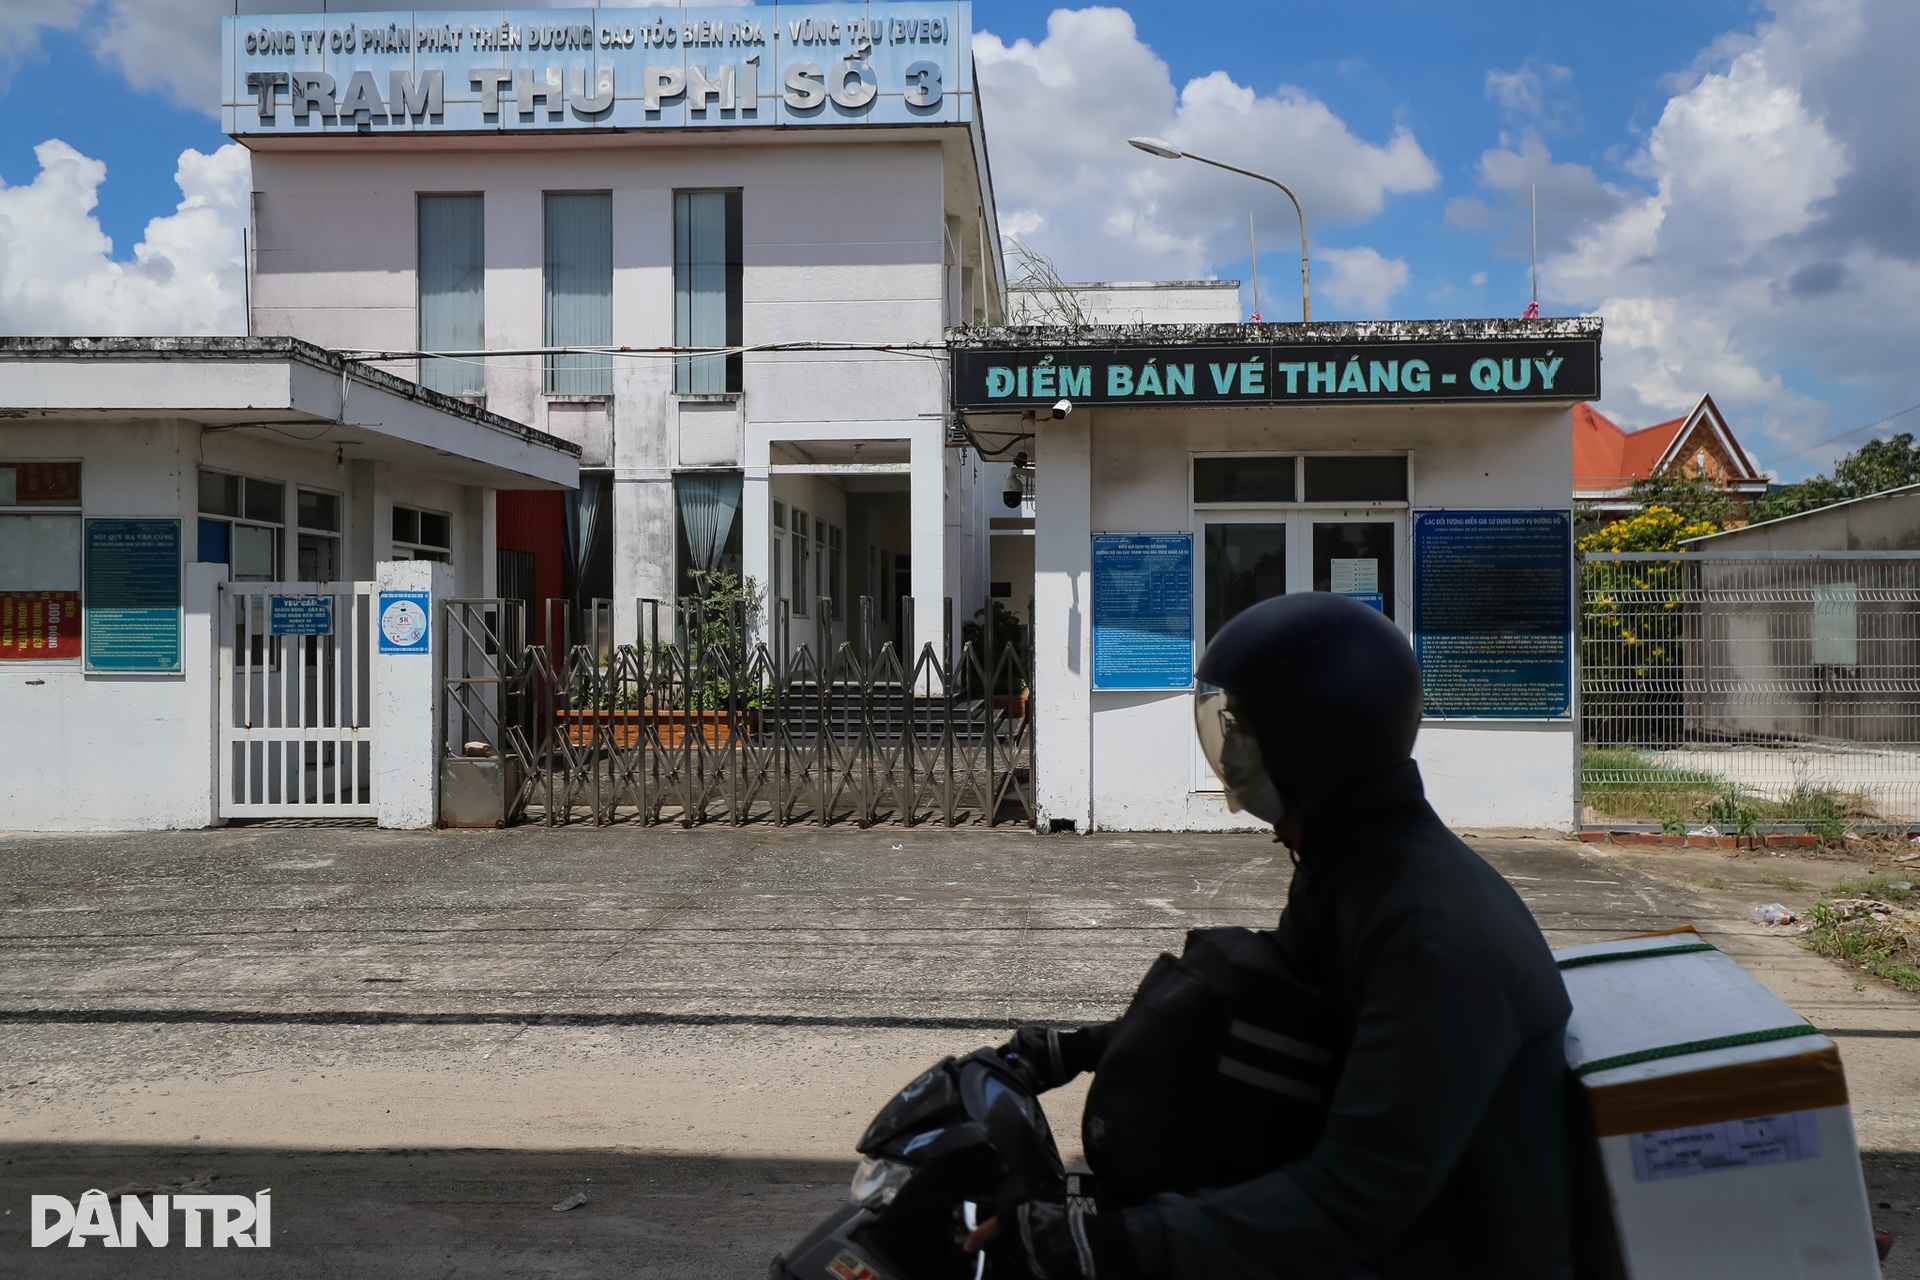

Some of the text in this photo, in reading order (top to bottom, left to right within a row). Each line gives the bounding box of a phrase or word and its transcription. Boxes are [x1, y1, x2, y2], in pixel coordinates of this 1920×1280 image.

[244, 27, 295, 51] CÔNG
[301, 29, 326, 51] TY
[330, 22, 356, 51] CỔ
[416, 24, 463, 49] PHÁT
[599, 24, 635, 46] CAO
[640, 16, 677, 45] TỐC
[682, 20, 723, 43] BIÊN
[729, 18, 765, 43] HÒA
[847, 17, 884, 40] TÀU
[888, 16, 949, 41] (BVEC)
[469, 66, 614, 116] THU
[644, 54, 761, 111] PHÍ
[783, 42, 877, 109] SỐ
[903, 60, 944, 107] 3
[985, 349, 1564, 398] ĐIỂM BÁN VÉ THÁNG - QUÝ
[108, 533, 123, 541] QUY
